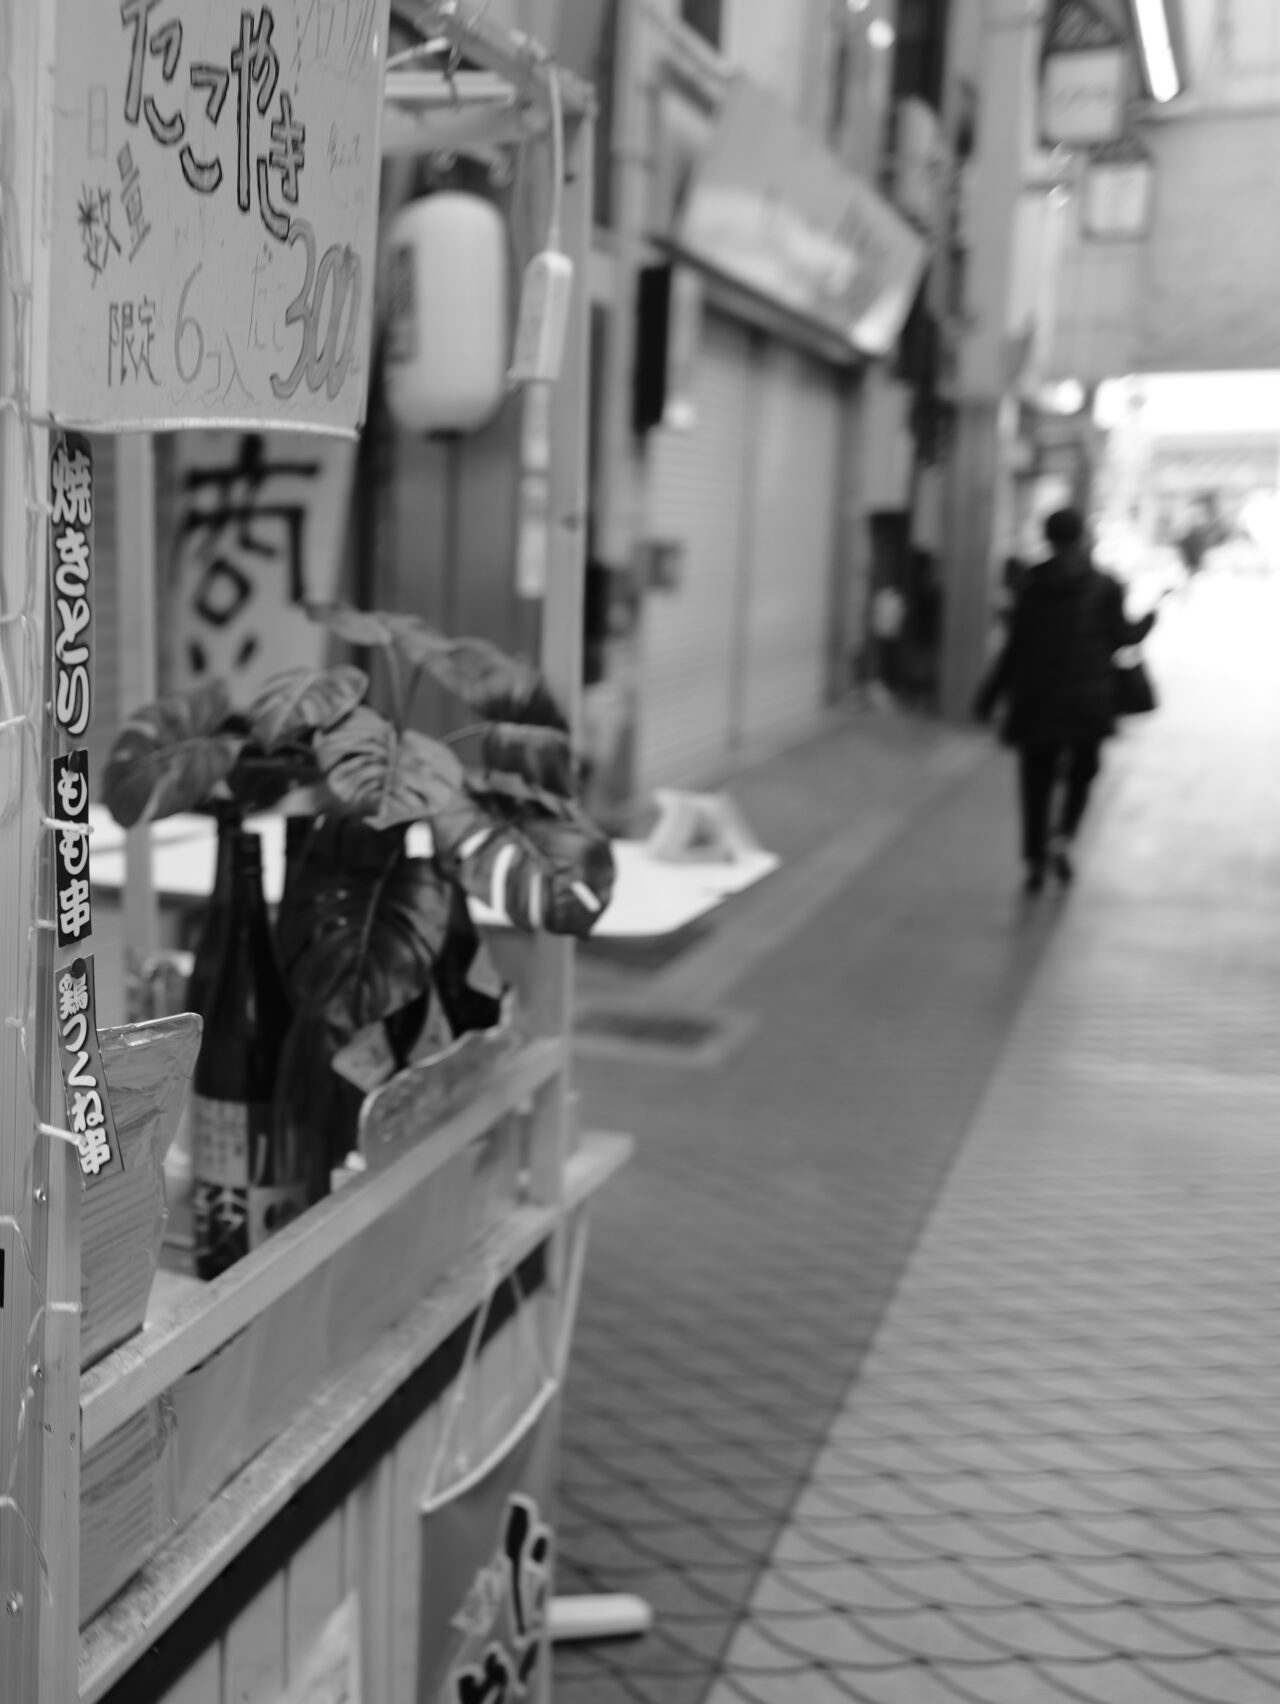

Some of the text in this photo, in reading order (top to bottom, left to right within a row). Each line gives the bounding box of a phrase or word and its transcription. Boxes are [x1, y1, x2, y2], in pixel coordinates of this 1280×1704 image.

[270, 217, 362, 401] 300
[51, 447, 91, 736] 焼きとり
[57, 767, 90, 938] もも串
